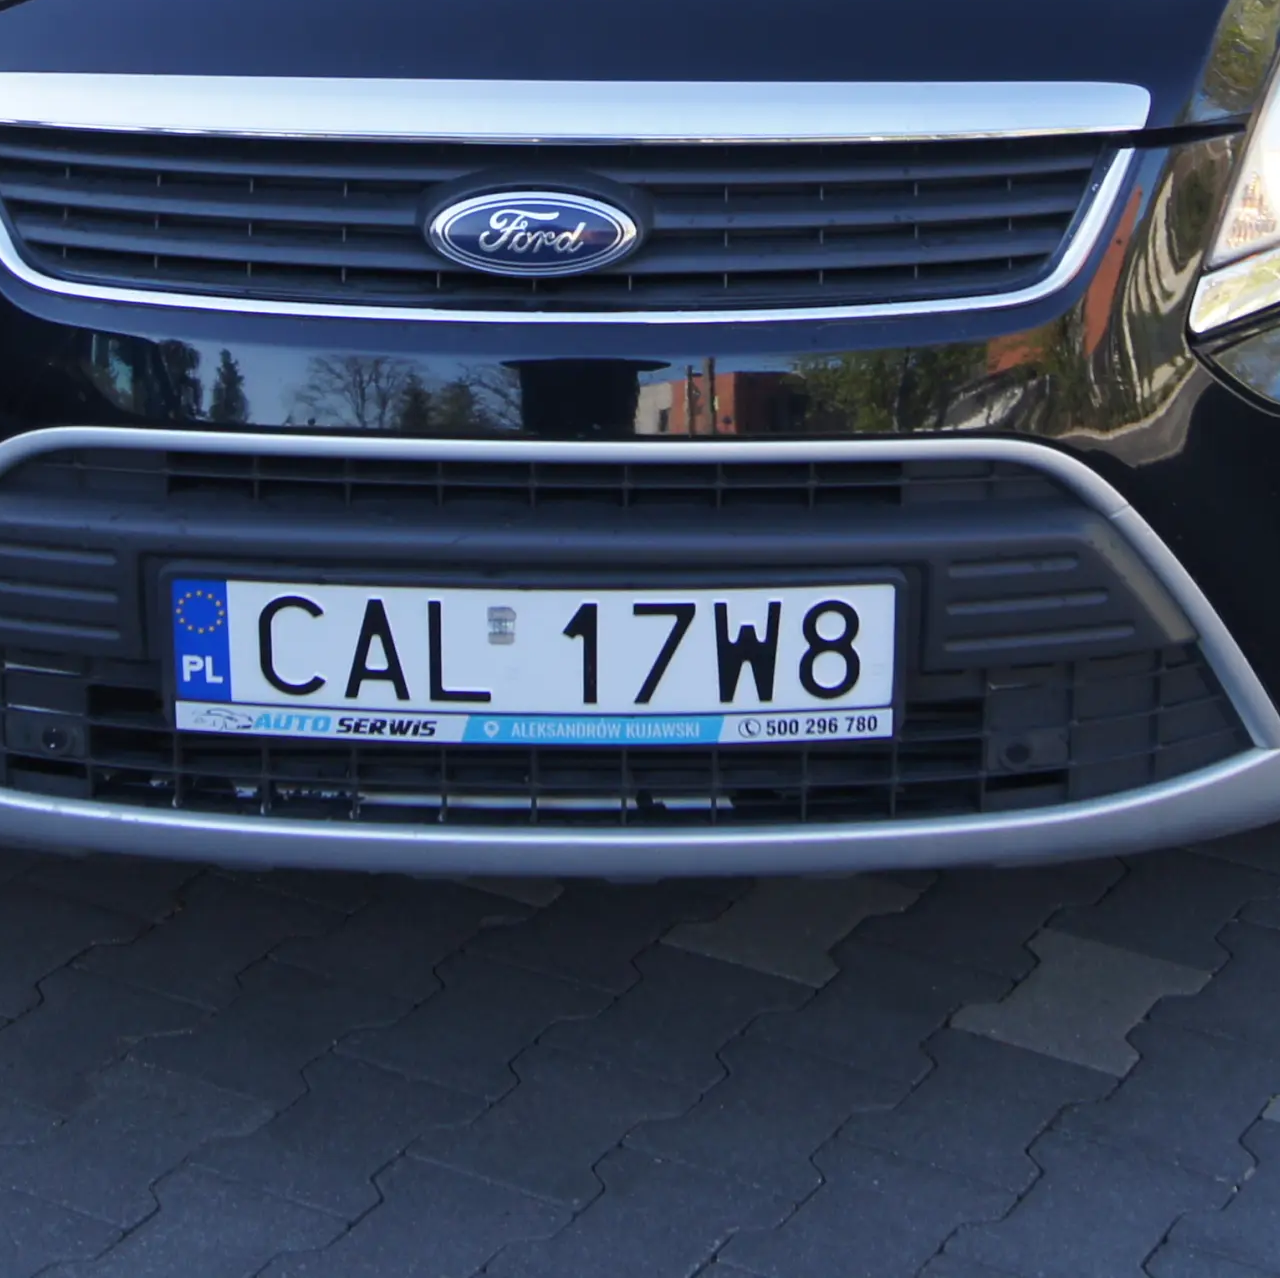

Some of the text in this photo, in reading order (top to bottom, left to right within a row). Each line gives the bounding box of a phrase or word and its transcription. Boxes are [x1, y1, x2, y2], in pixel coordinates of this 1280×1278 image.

[479, 209, 587, 254] Ford
[258, 595, 861, 705] CAL 17W8
[181, 656, 223, 684] PL
[252, 713, 438, 737] AUTO SERWIS
[511, 720, 700, 738] ALEKSANDRÓW KUJAWSKI
[766, 715, 878, 737] 500 296 780
